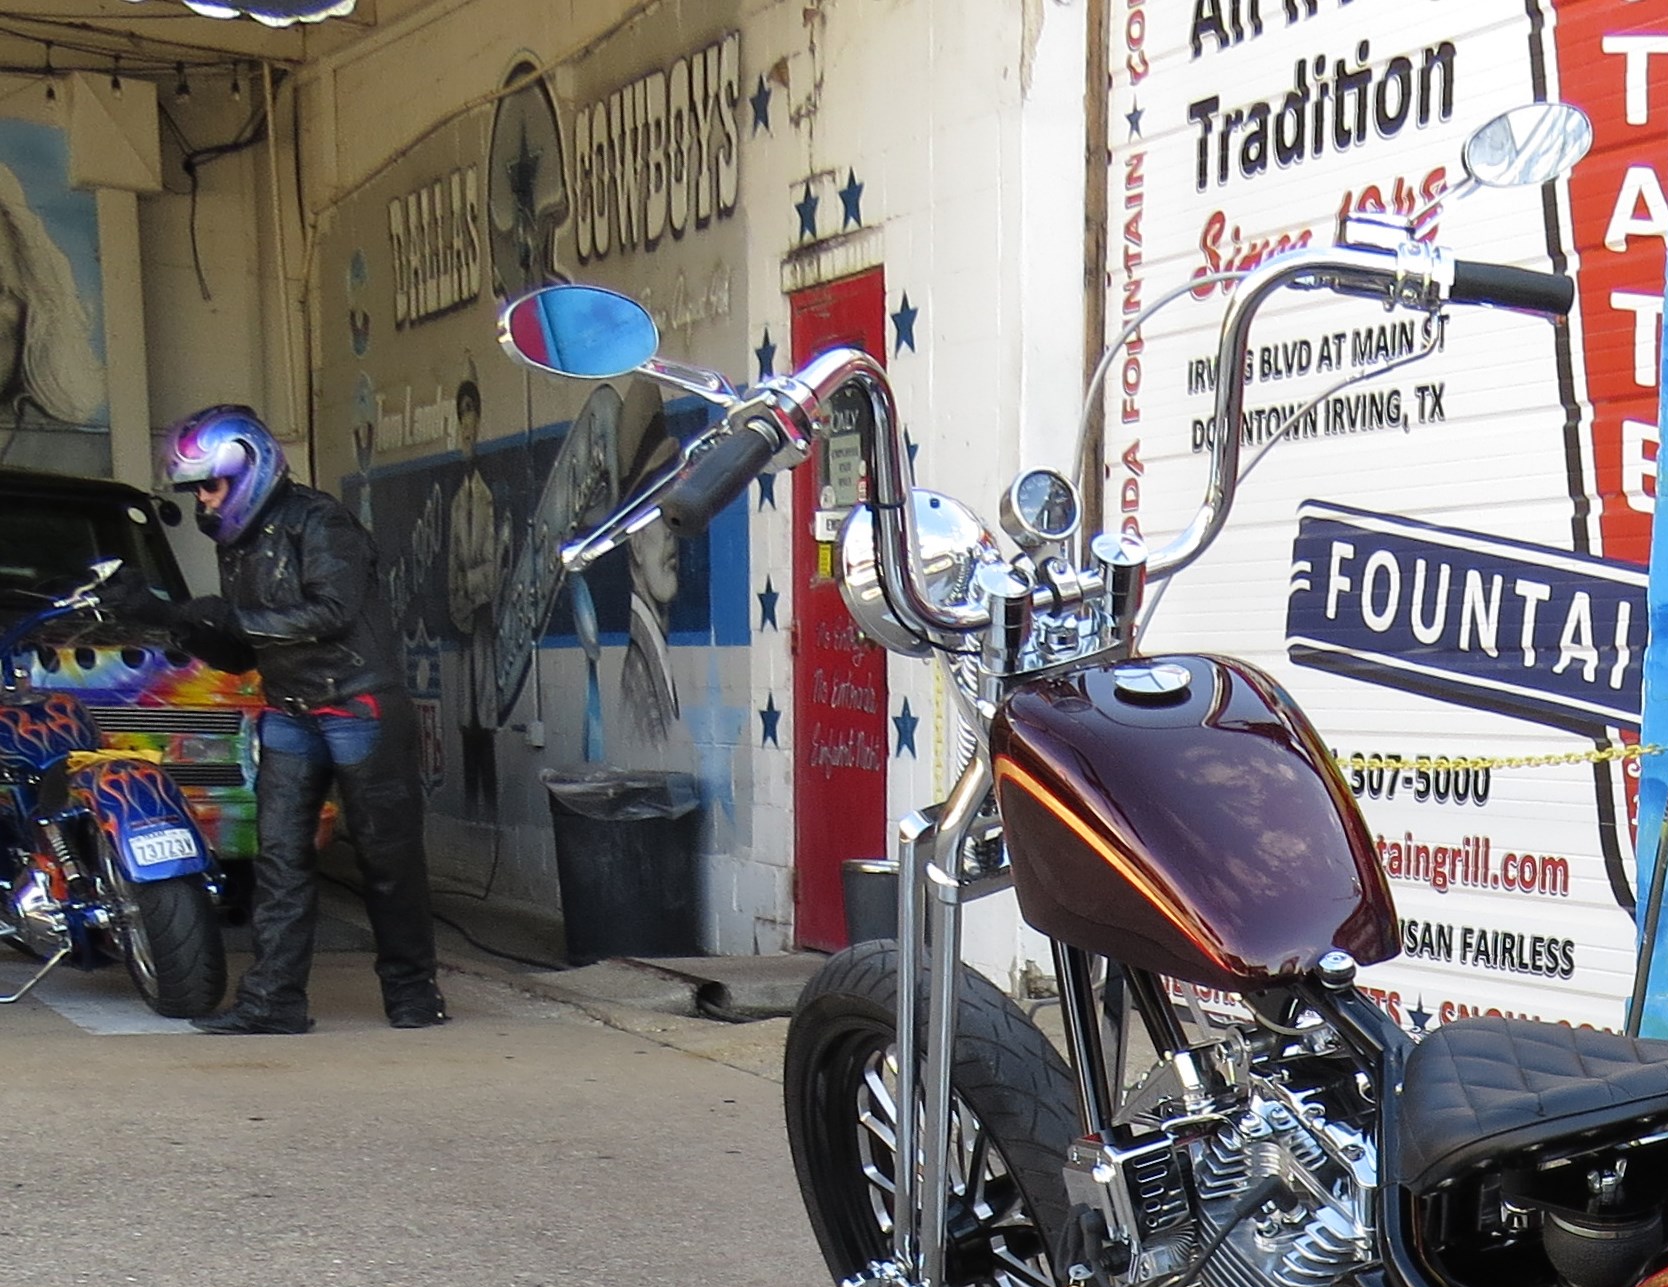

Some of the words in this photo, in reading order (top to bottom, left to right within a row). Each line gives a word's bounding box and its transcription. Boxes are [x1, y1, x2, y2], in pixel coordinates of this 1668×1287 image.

[1126, 0, 1149, 87] CO
[1189, 39, 1458, 190] Tradition
[388, 164, 482, 331] DALLAS
[573, 30, 742, 264] COWBOYS
[1121, 151, 1148, 424] FOUNTAIN
[1188, 350, 1256, 394] IRVG
[1259, 338, 1314, 381] BLVD
[1317, 332, 1347, 373] AT
[1351, 320, 1416, 367] MAIN
[1192, 401, 1320, 453] DONTOWN
[1324, 388, 1411, 434] IRVING,
[1416, 382, 1446, 423] TX
[1350, 752, 1492, 806] 307-5000
[1461, 926, 1577, 979] FAIRLESS
